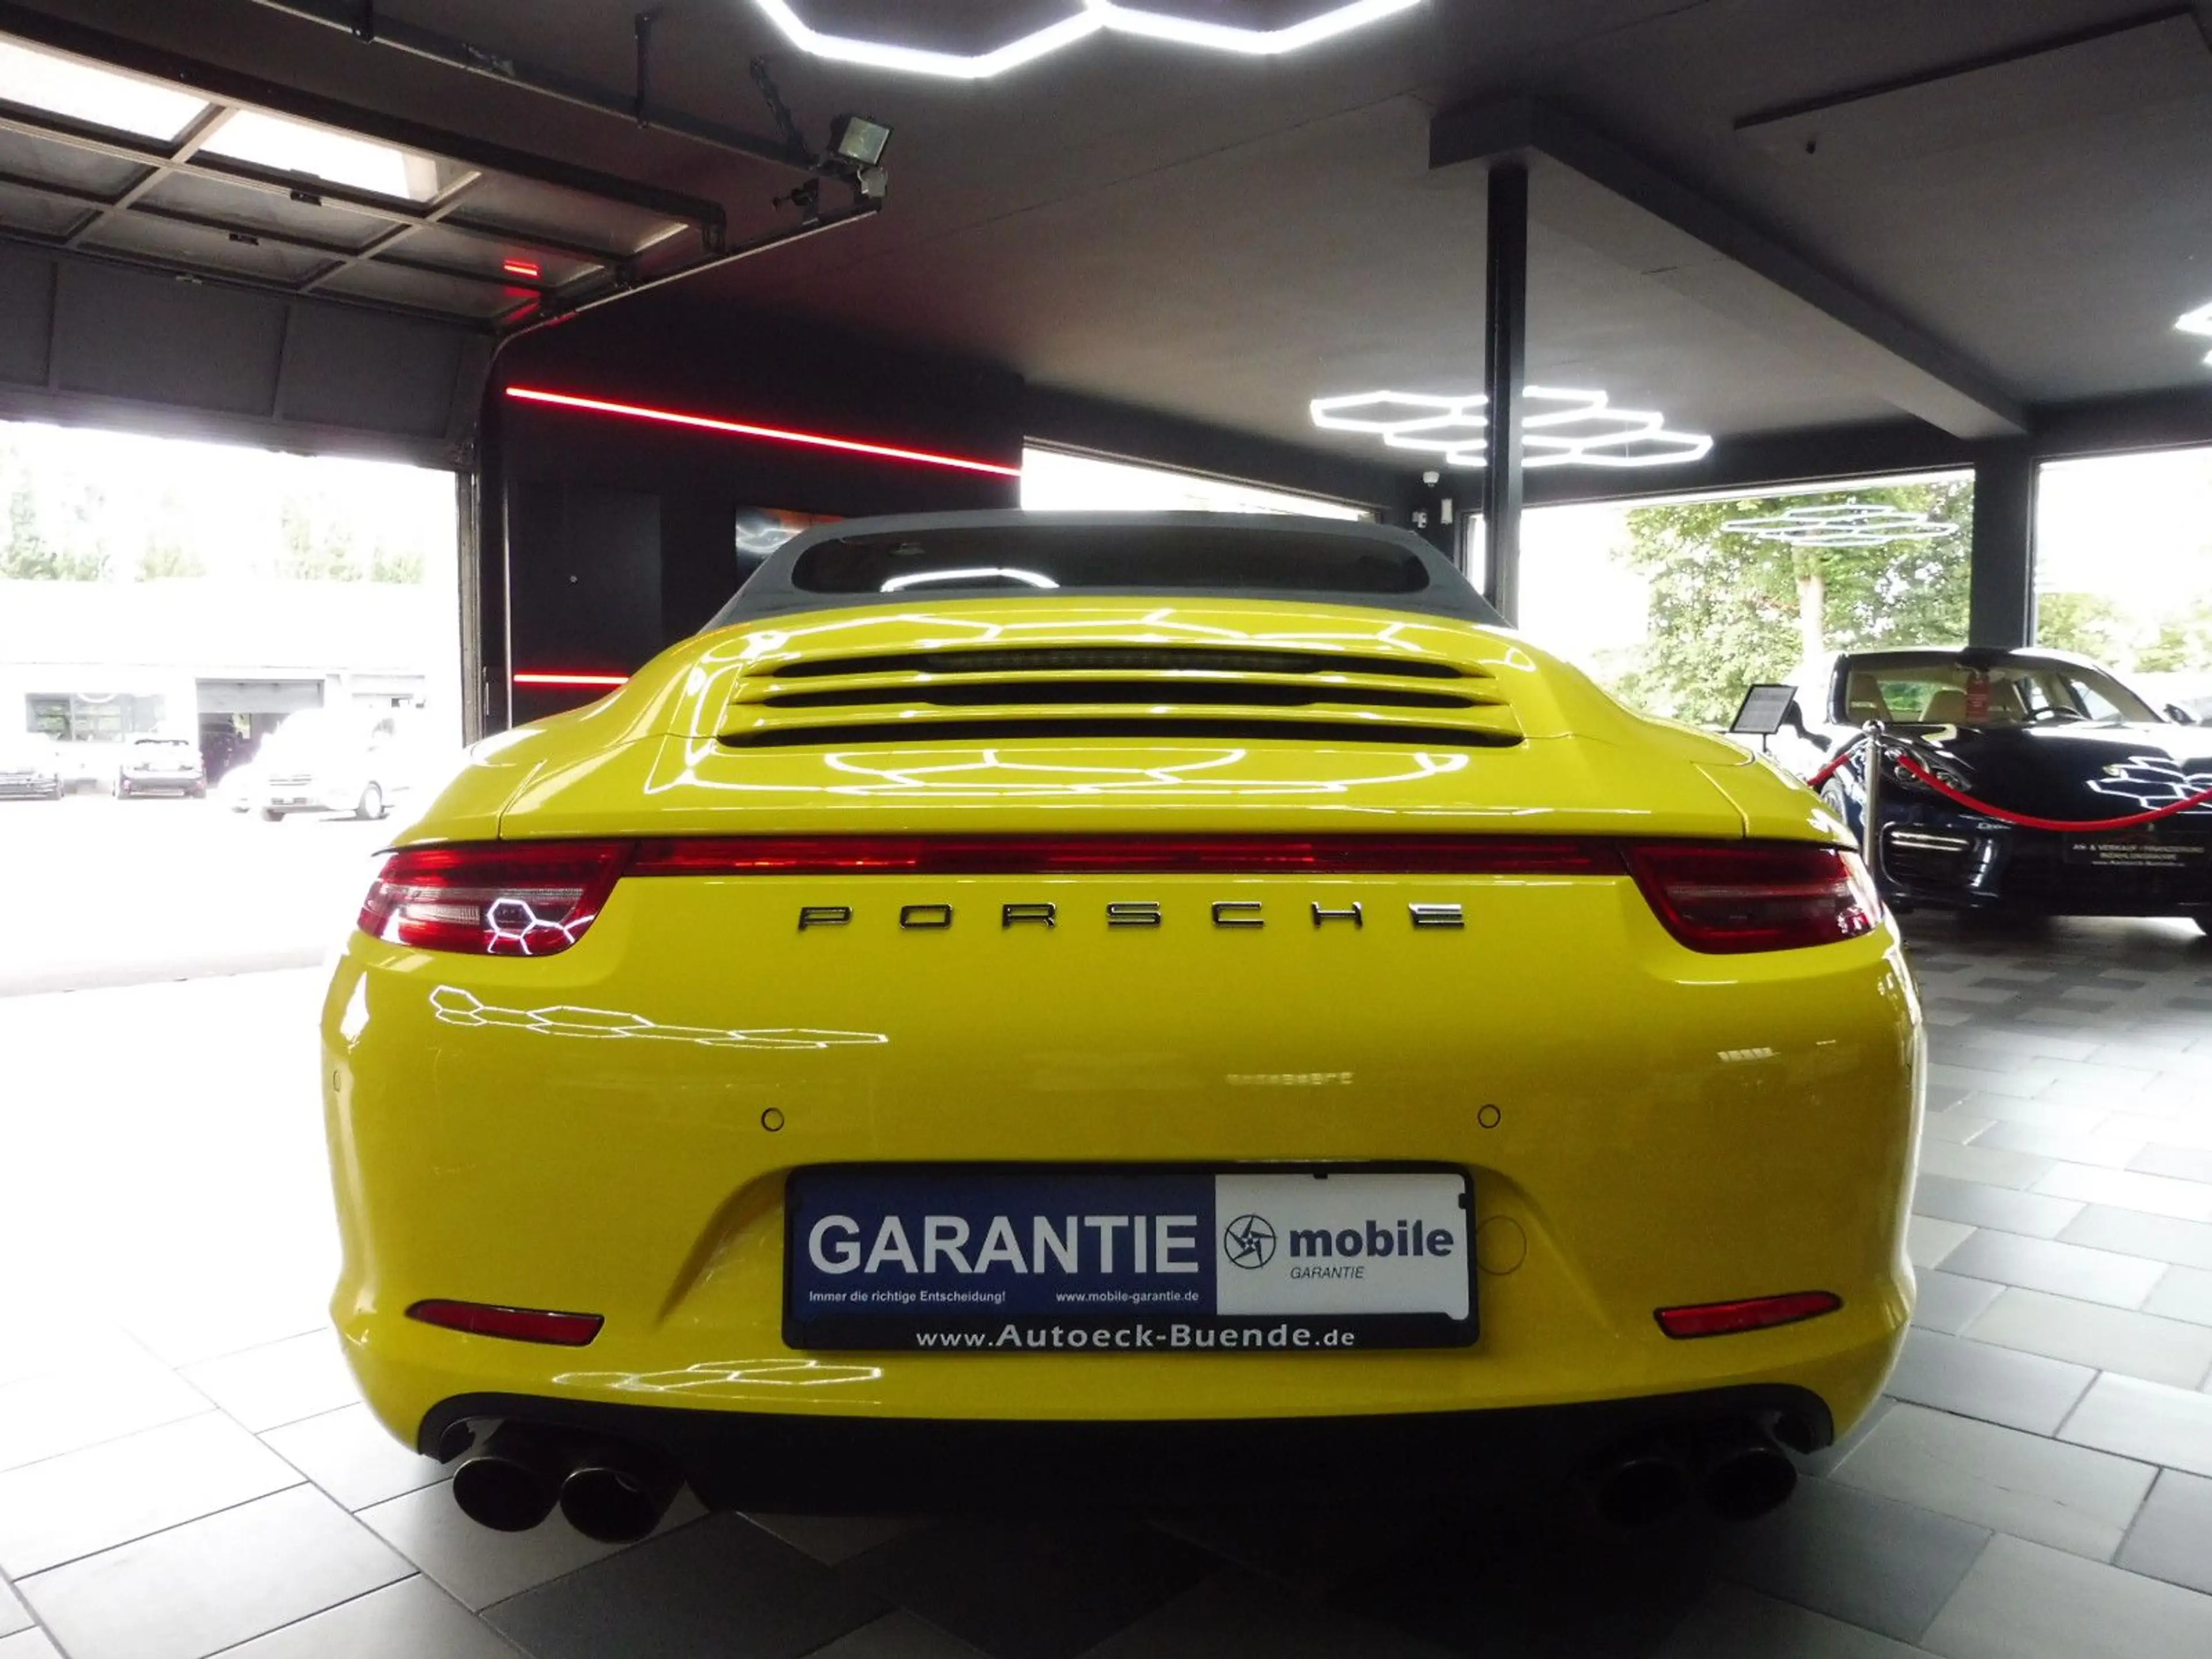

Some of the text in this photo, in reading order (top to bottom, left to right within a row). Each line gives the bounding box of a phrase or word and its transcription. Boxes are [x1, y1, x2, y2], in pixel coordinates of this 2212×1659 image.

[798, 902, 1465, 930] PORSCHE
[809, 1215, 1199, 1274] GARANTIE
[1290, 1219, 1454, 1257] mobile
[1290, 1266, 1365, 1279] GARANTIE
[809, 1290, 1006, 1304] Immer die richtige Entscheidung!
[1056, 1290, 1199, 1304] www.mobile-garantie.de
[916, 1324, 1355, 1348] www.Autoeck-Buende.de
